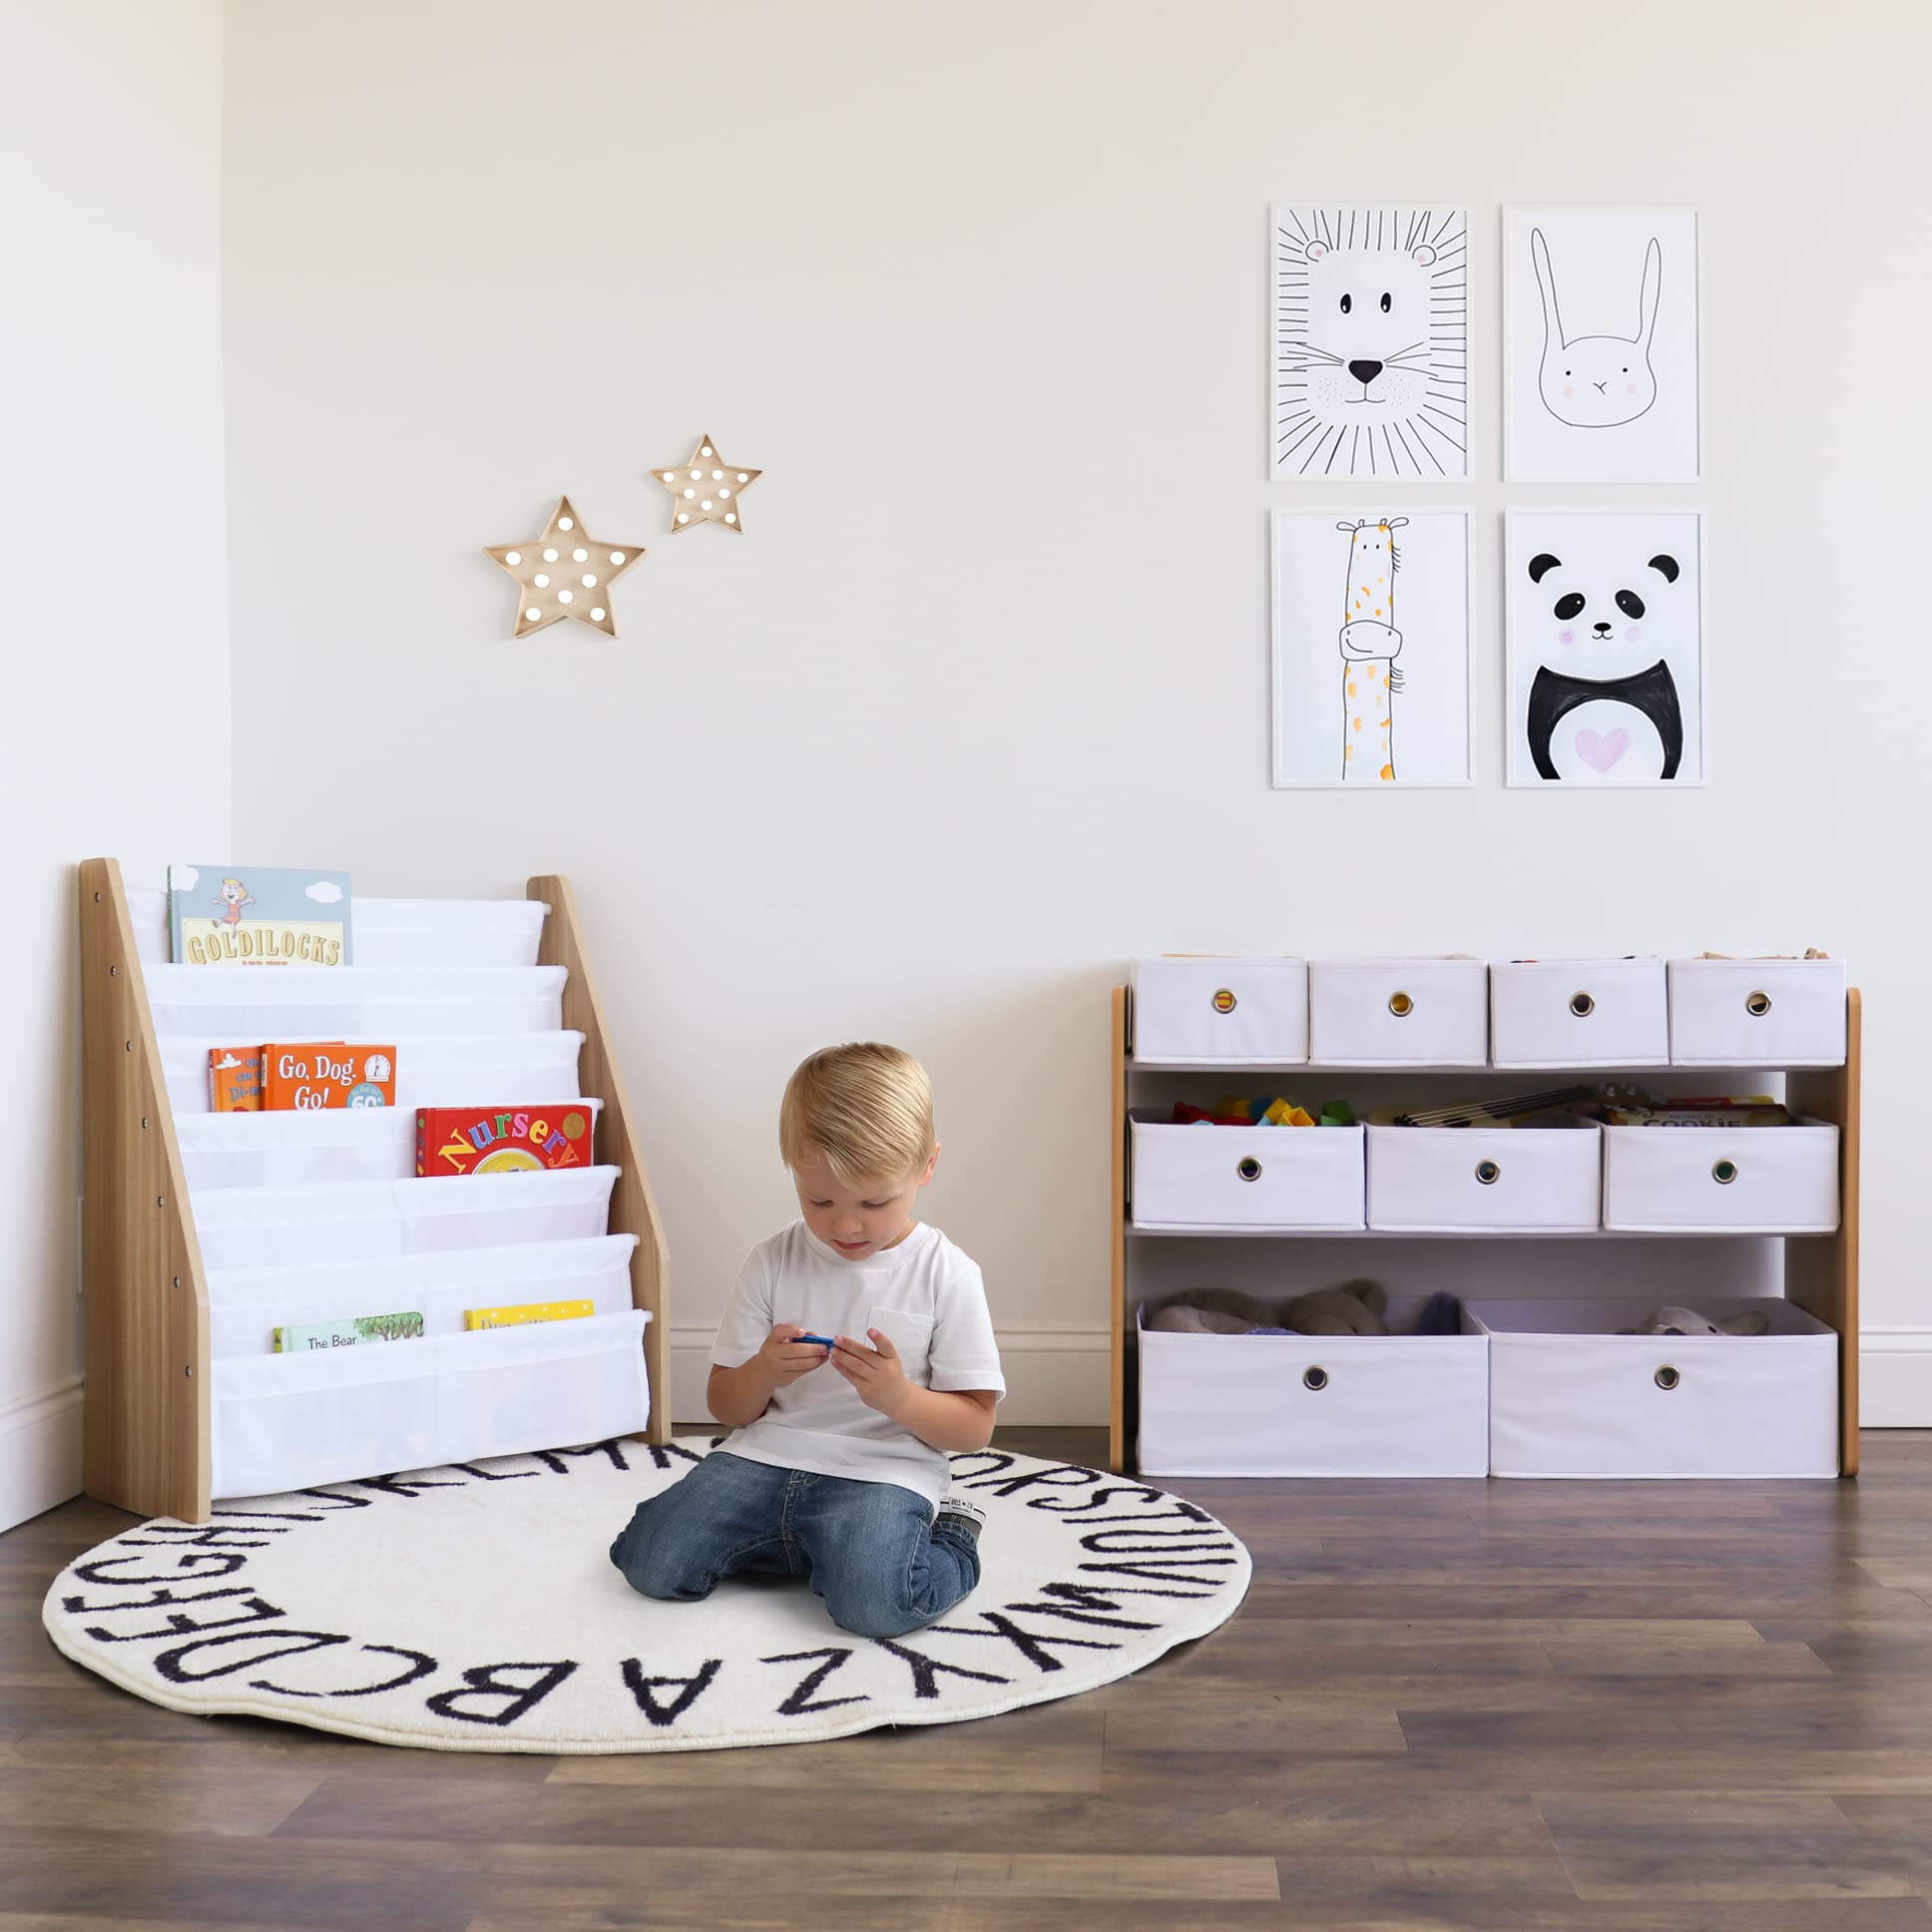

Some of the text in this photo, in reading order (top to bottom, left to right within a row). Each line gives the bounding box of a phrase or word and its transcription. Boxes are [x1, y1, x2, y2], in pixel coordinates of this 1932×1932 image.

[187, 929, 340, 966] GOLDILOCKS
[278, 1054, 310, 1081] Go,
[314, 1055, 357, 1087] Dog.
[294, 1085, 329, 1110] Go!
[437, 1113, 580, 1175] Nursery
[307, 1334, 357, 1350] The Bear
[962, 1465, 1102, 1497] R
[1026, 1487, 1165, 1513] S
[1062, 1502, 1213, 1524] T
[118, 1526, 291, 1548] H
[1079, 1528, 1235, 1554] U
[73, 1552, 248, 1586] G
[1077, 1558, 1237, 1587] V
[62, 1587, 256, 1614] F
[1005, 1582, 1218, 1631] W
[85, 1597, 286, 1644] E
[153, 1629, 352, 1684] D
[928, 1611, 1124, 1673] X
[248, 1644, 438, 1697] C
[759, 1647, 872, 1716] Z
[870, 1638, 1018, 1698] Y
[424, 1659, 580, 1726] B
[620, 1658, 723, 1727] A
